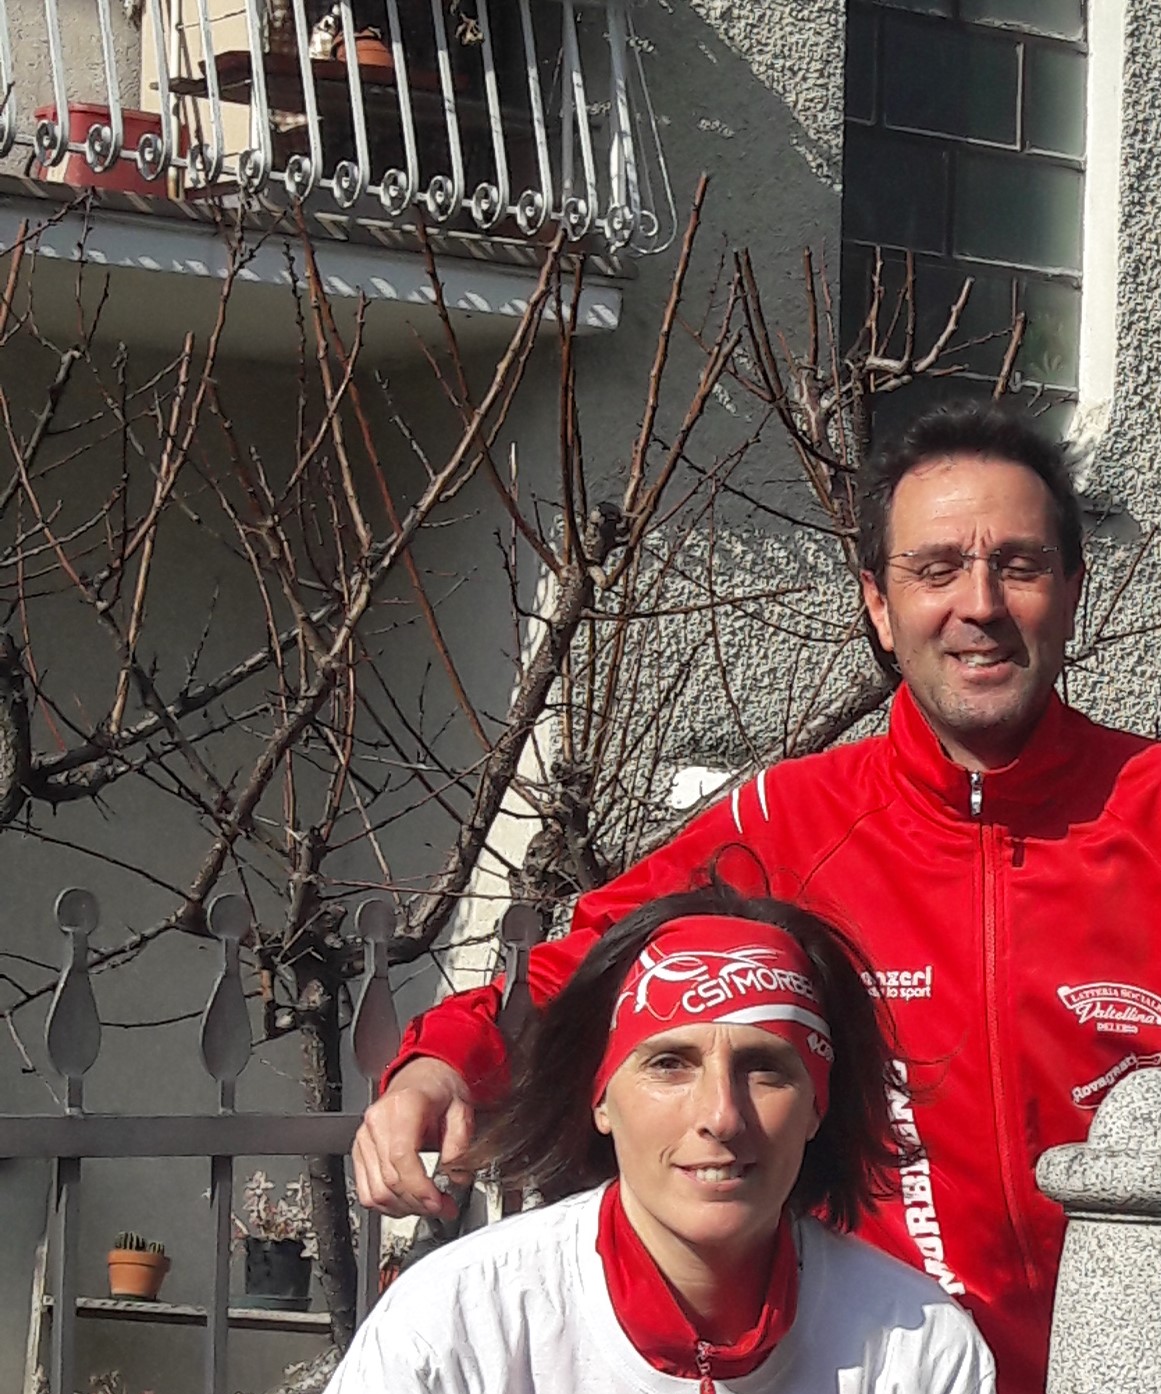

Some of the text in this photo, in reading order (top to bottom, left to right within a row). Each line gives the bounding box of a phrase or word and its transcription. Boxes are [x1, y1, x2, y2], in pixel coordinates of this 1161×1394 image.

[682, 976, 734, 1014] CSI
[900, 985, 931, 1003] sport
[1075, 1001, 1157, 1025] Valtellina
